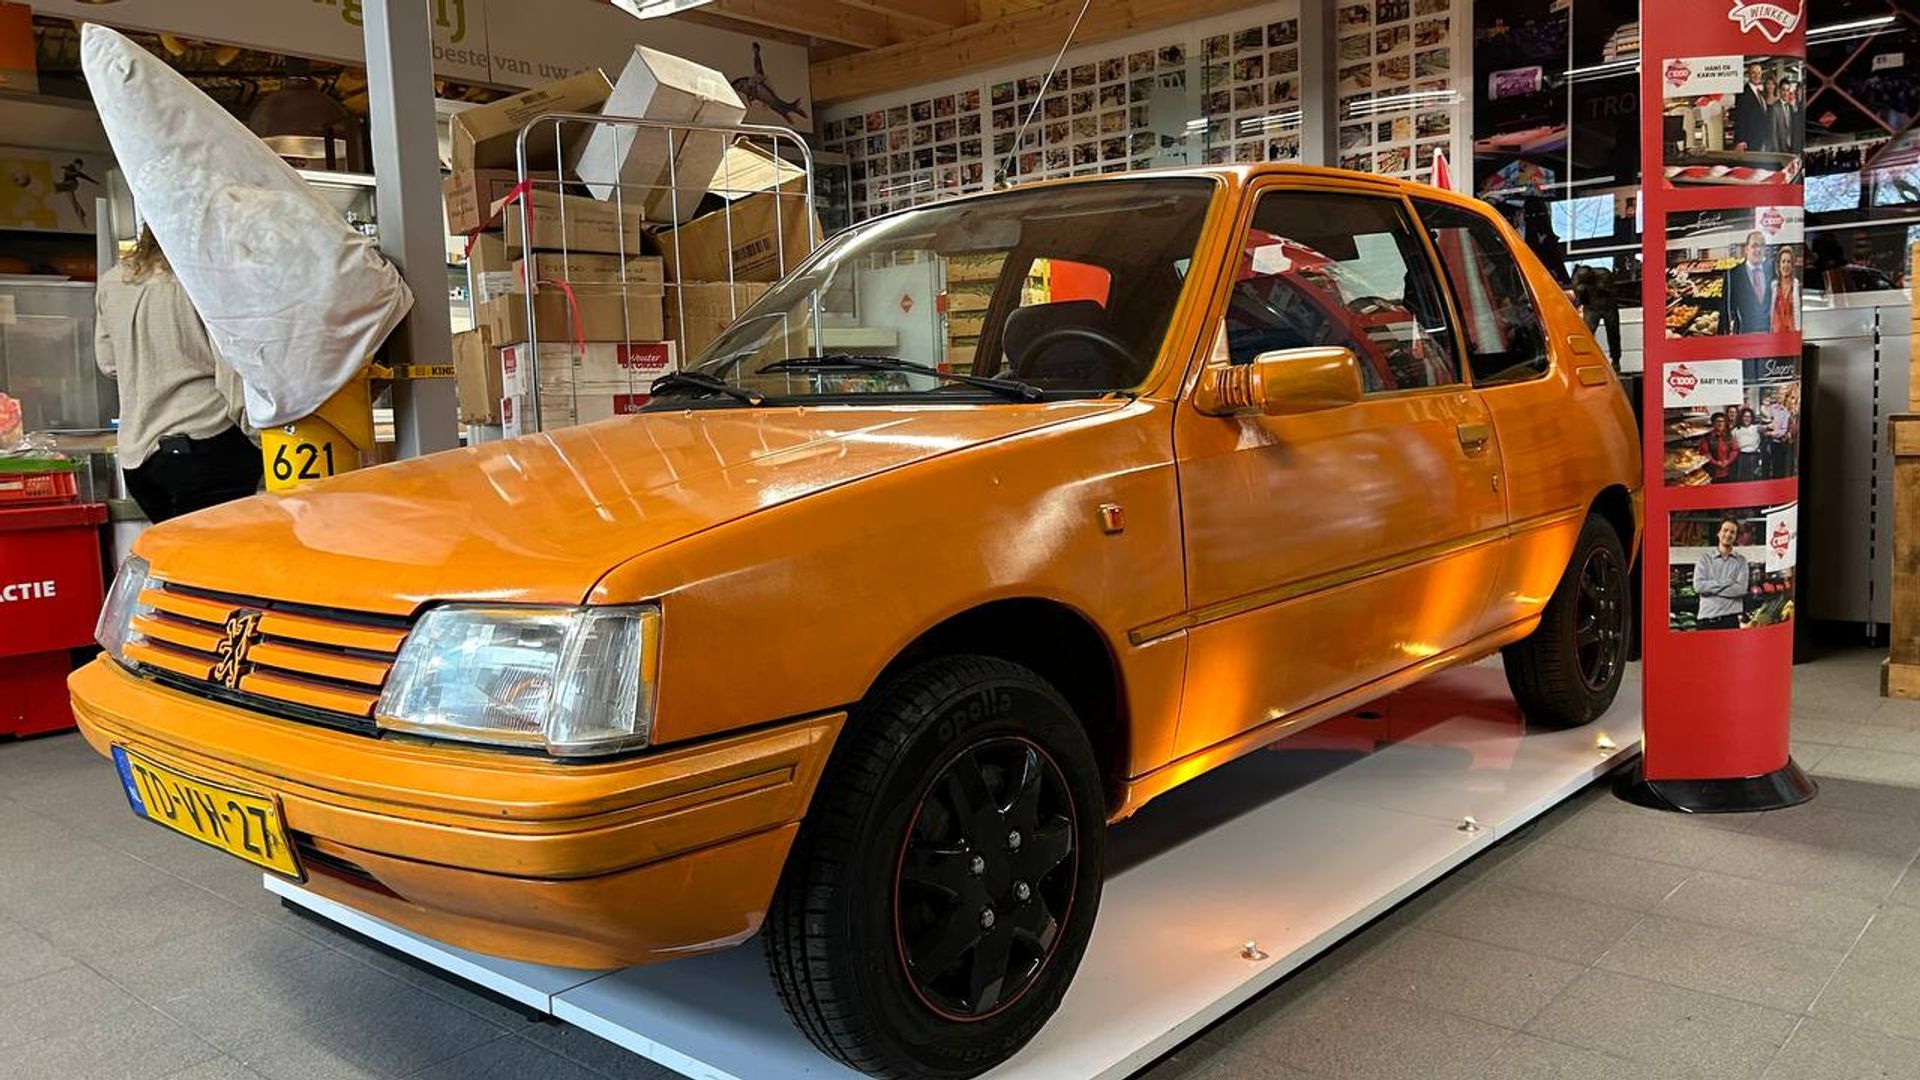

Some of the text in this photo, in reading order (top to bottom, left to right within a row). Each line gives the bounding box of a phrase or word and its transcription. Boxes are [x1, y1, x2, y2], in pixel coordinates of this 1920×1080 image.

[1751, 6, 1788, 23] WINKEL
[432, 39, 488, 68] beste
[494, 54, 533, 75] van
[538, 64, 569, 80] uw
[273, 442, 334, 481] 621
[0, 580, 56, 602] CTIE
